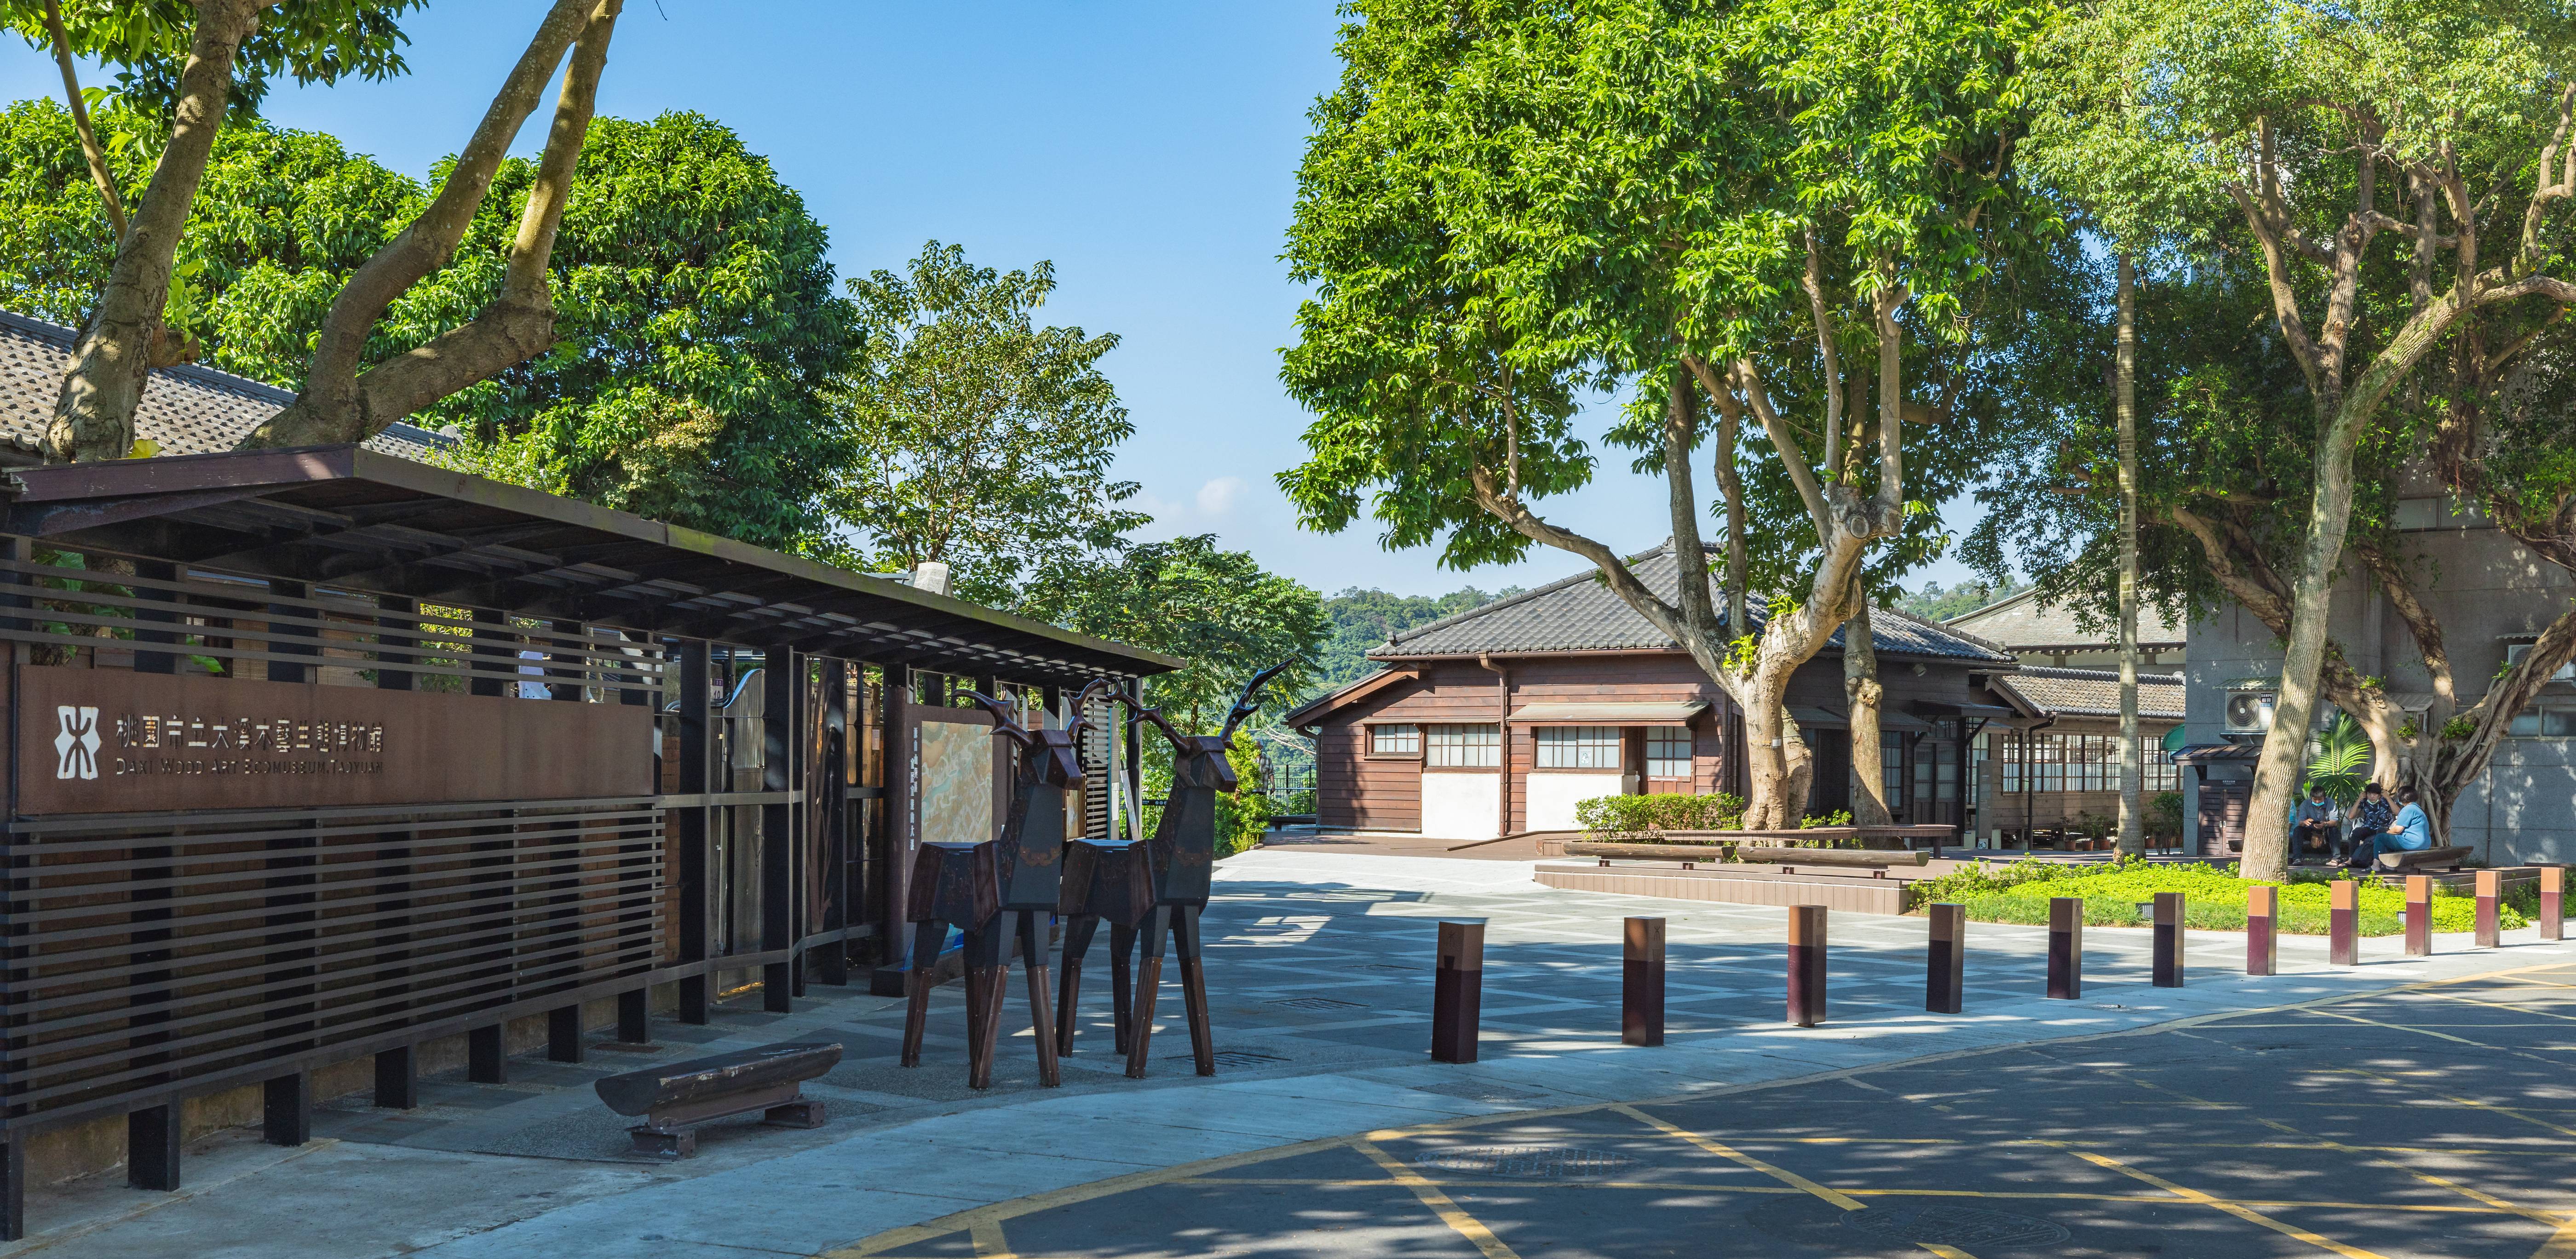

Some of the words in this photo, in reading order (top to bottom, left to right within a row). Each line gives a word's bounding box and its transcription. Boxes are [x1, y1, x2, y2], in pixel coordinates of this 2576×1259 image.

[713, 690, 720, 699] 10
[116, 714, 385, 752] 桃園市立大溪木藝生態博物館
[116, 758, 153, 775] DAXI
[161, 758, 204, 774] WOOD
[211, 759, 238, 774] ART
